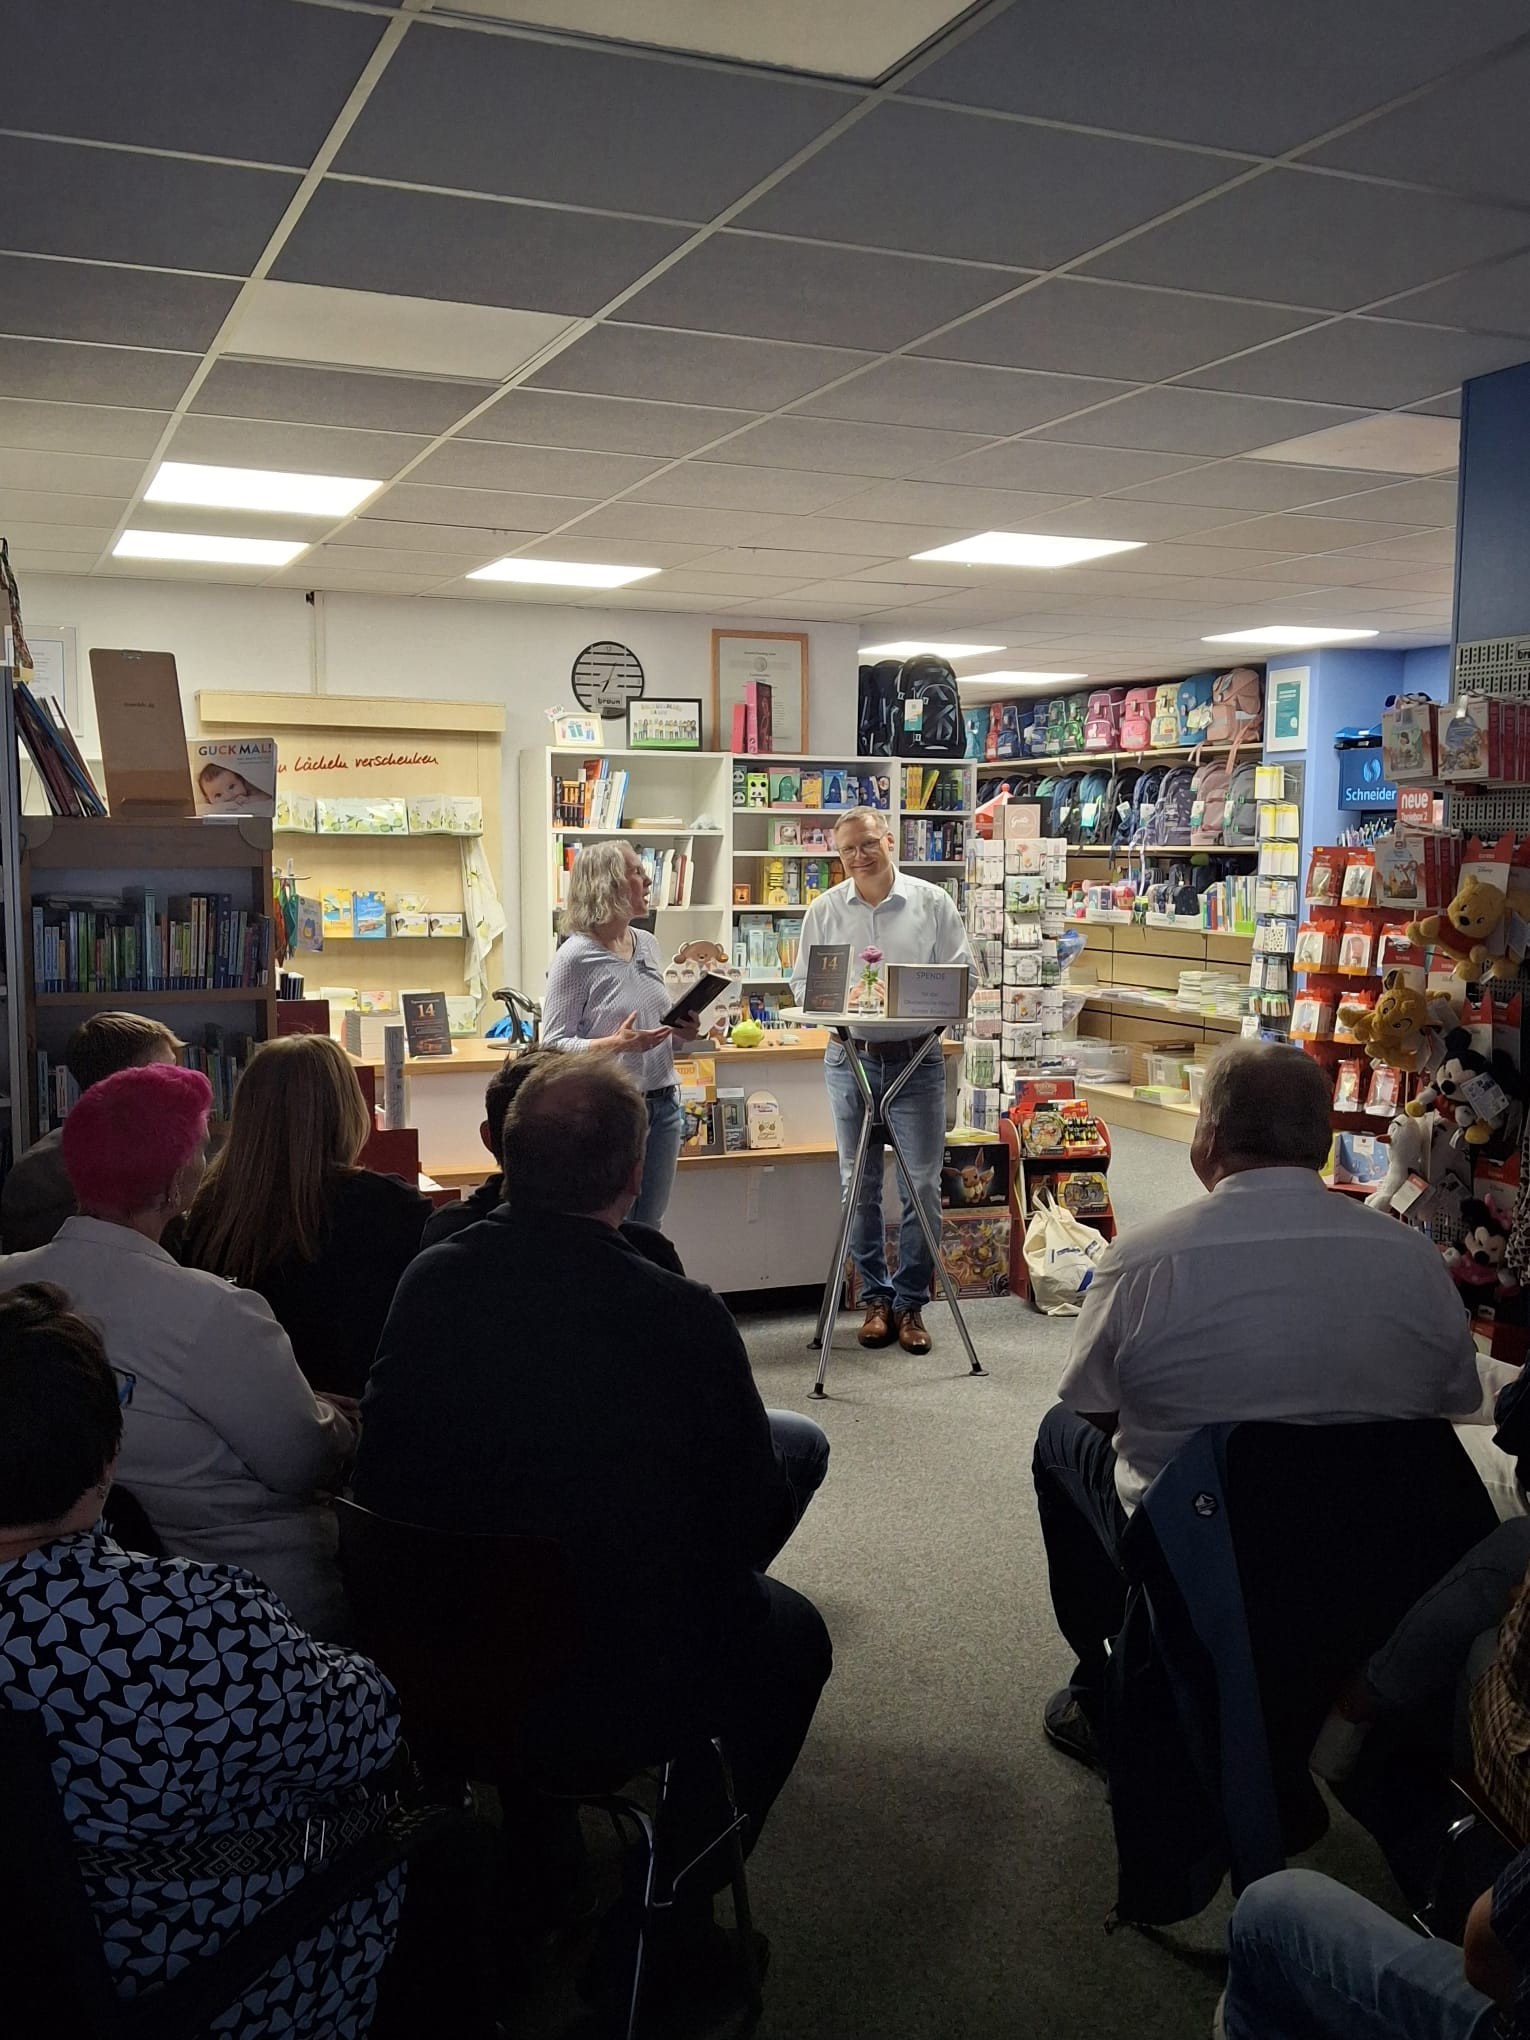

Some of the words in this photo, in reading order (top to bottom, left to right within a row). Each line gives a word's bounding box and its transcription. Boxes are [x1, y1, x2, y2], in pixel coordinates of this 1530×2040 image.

[198, 744, 236, 756] GUCK
[239, 743, 272, 755] MAL!
[294, 754, 348, 772] Lächeln
[355, 752, 439, 768] verschenken
[1345, 787, 1397, 801] Schneider
[1401, 792, 1429, 809] neue
[821, 956, 838, 970] 14
[916, 971, 945, 980] SPENDE
[417, 1003, 435, 1018] 14
